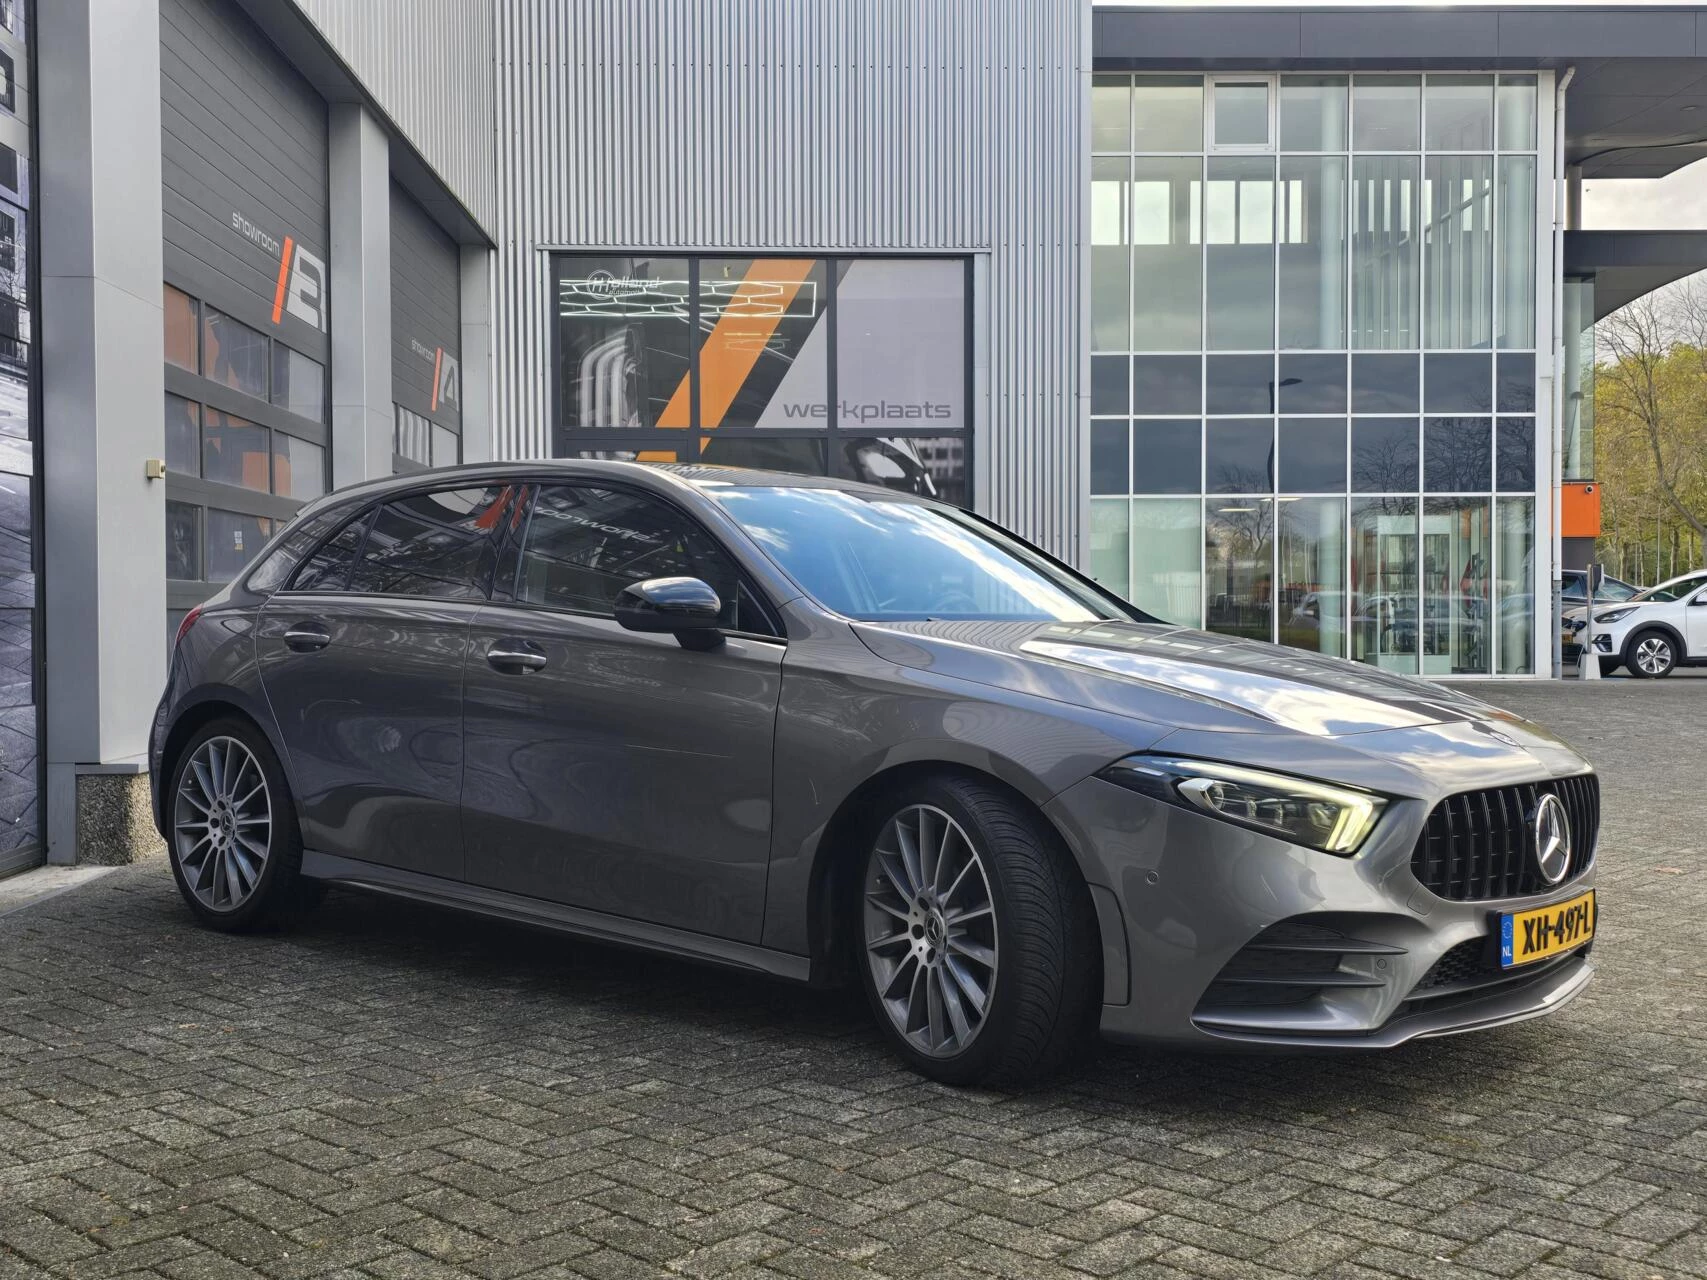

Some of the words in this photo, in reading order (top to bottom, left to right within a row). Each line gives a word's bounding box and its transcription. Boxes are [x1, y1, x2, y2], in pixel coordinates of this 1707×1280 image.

[232, 211, 280, 257] showroom
[783, 400, 952, 424] wekplaats
[1522, 901, 1591, 955] XH-497-L
[1502, 946, 1512, 957] NL
